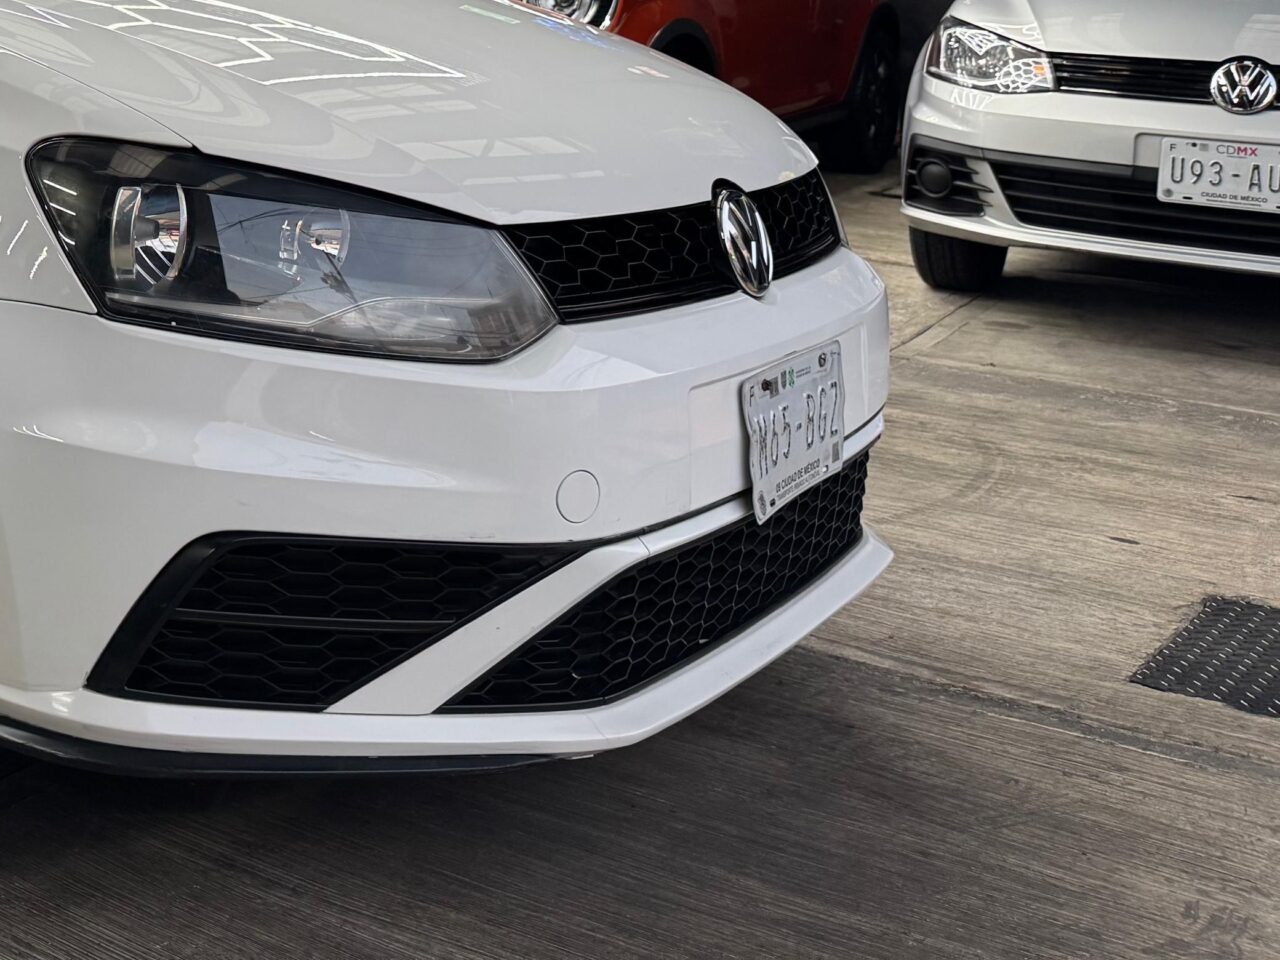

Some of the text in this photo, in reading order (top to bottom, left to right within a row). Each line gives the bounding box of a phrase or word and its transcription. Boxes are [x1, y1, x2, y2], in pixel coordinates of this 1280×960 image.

[1169, 143, 1177, 152] F
[1216, 144, 1258, 157] CDMX
[1201, 191, 1228, 199] CIUDAD
[1229, 193, 1238, 201] DE
